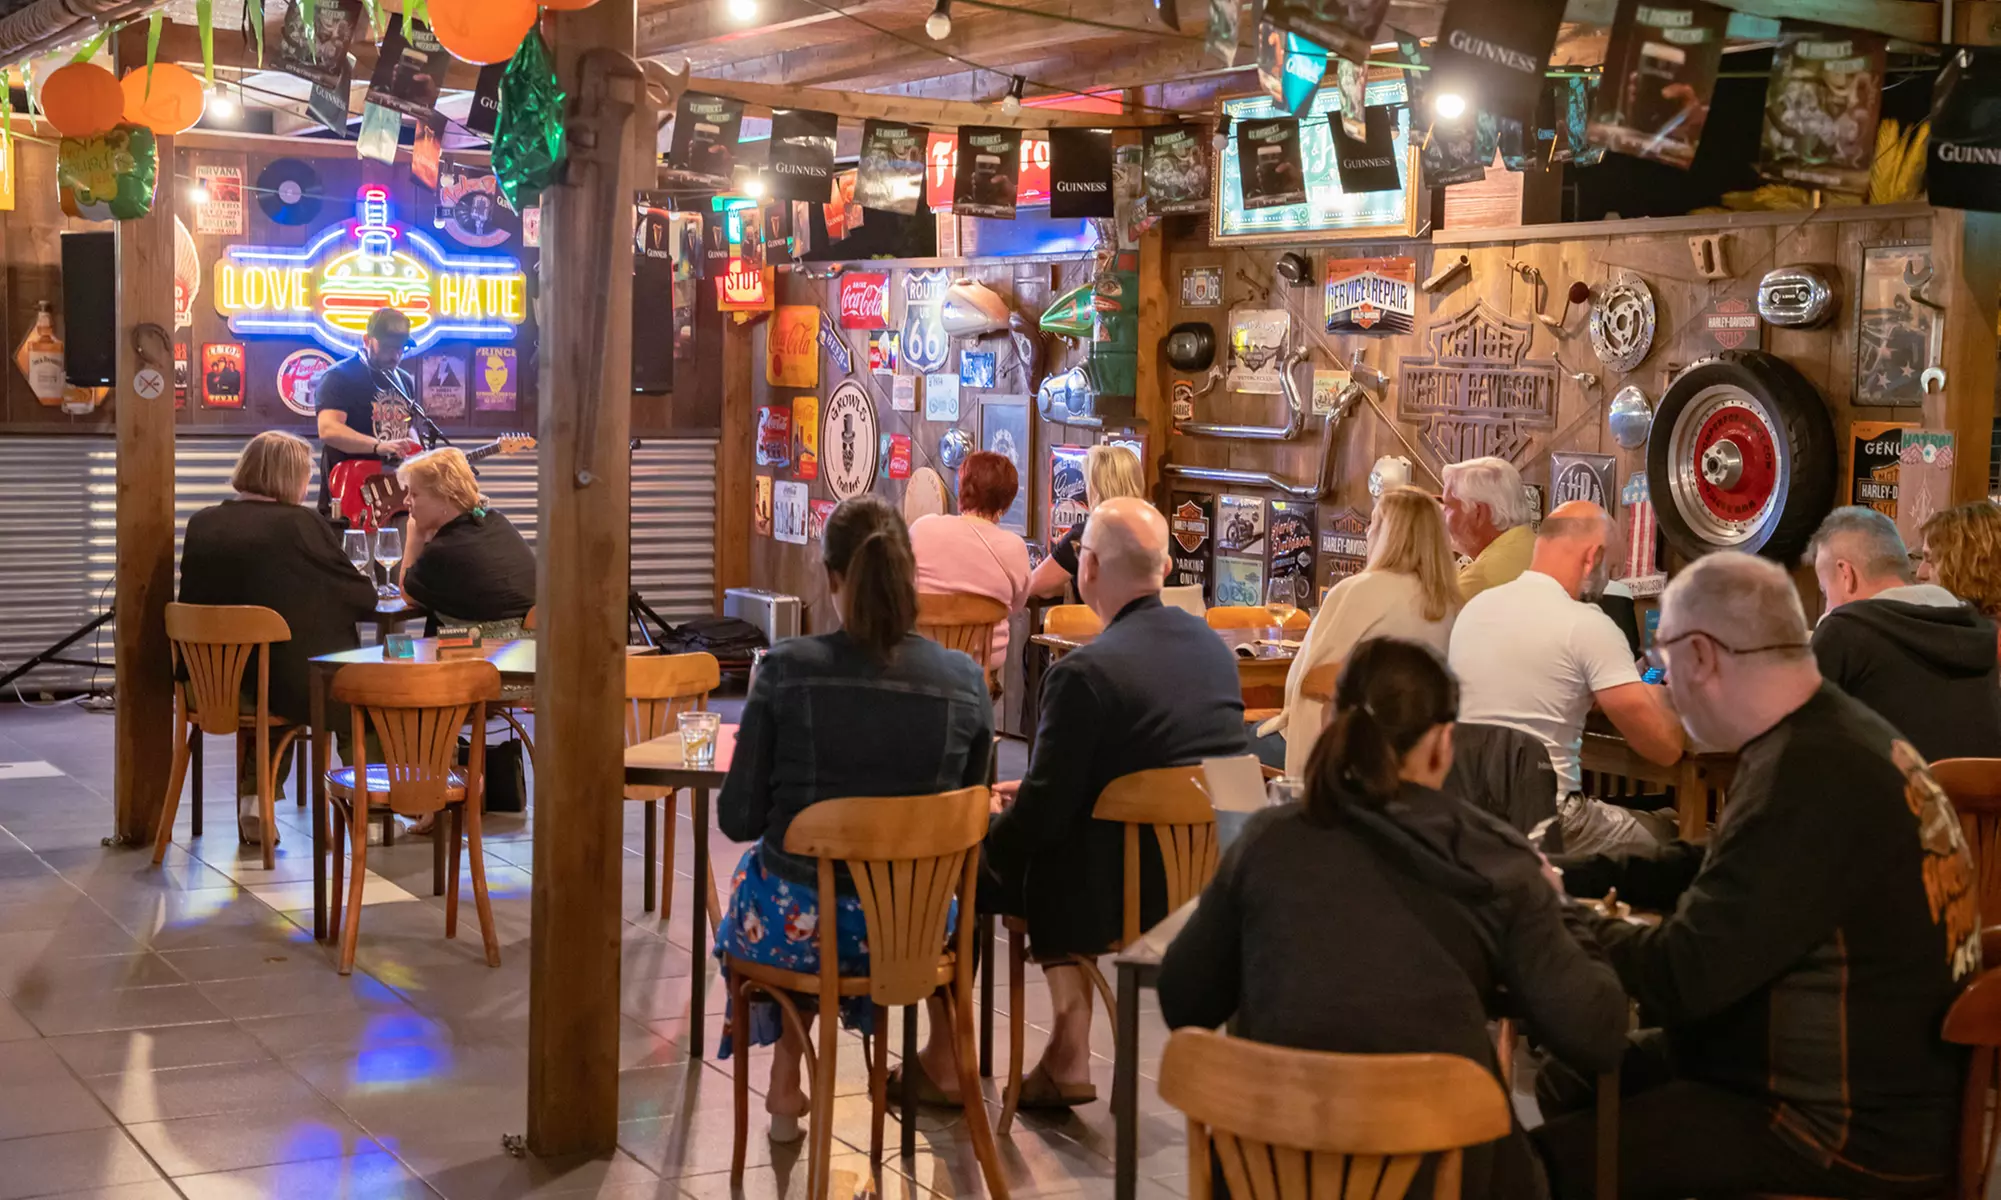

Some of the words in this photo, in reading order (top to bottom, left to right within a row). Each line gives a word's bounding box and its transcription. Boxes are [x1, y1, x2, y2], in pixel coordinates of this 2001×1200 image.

[1449, 29, 1537, 73] GUINNESS
[315, 85, 346, 111] GUINNESS
[1938, 141, 2001, 166] GUINN
[775, 162, 827, 177] GUINNESS
[1343, 157, 1391, 170] GUINNESS
[197, 167, 239, 177] NIRVANA
[1056, 180, 1107, 192] GUINNESS
[767, 238, 786, 249] GUINNESS
[647, 248, 668, 259] GUINNESS
[708, 250, 728, 259] GUINNESS
[727, 269, 760, 290] STOP
[1208, 275, 1219, 299] 66
[222, 265, 314, 311] LOVE
[439, 272, 523, 319] HATE
[1328, 277, 1366, 310] SERVICE
[1371, 277, 1408, 310] REPAIR
[841, 284, 882, 316] Coca-Cola
[920, 306, 931, 319] US
[1708, 315, 1756, 329] HARLEY-DAVIDSON
[908, 318, 940, 361] 66
[1440, 323, 1514, 359] MOTOR
[475, 348, 517, 357] PRINCE
[826, 334, 846, 365] BEER
[288, 357, 328, 380] Fender
[1407, 371, 1463, 407] HARLEY
[1468, 372, 1545, 410] DAVIDSON
[1173, 403, 1191, 417] GARAGE
[1864, 441, 1901, 456] GENU
[1878, 470, 1898, 480] MOT
[1861, 483, 1898, 499] HARLEY-D
[1335, 519, 1361, 533] MOTOR
[1322, 536, 1367, 556] HARLEY-DAVIDS
[1180, 572, 1199, 585] ONLY
[439, 627, 468, 635] RESERVED
